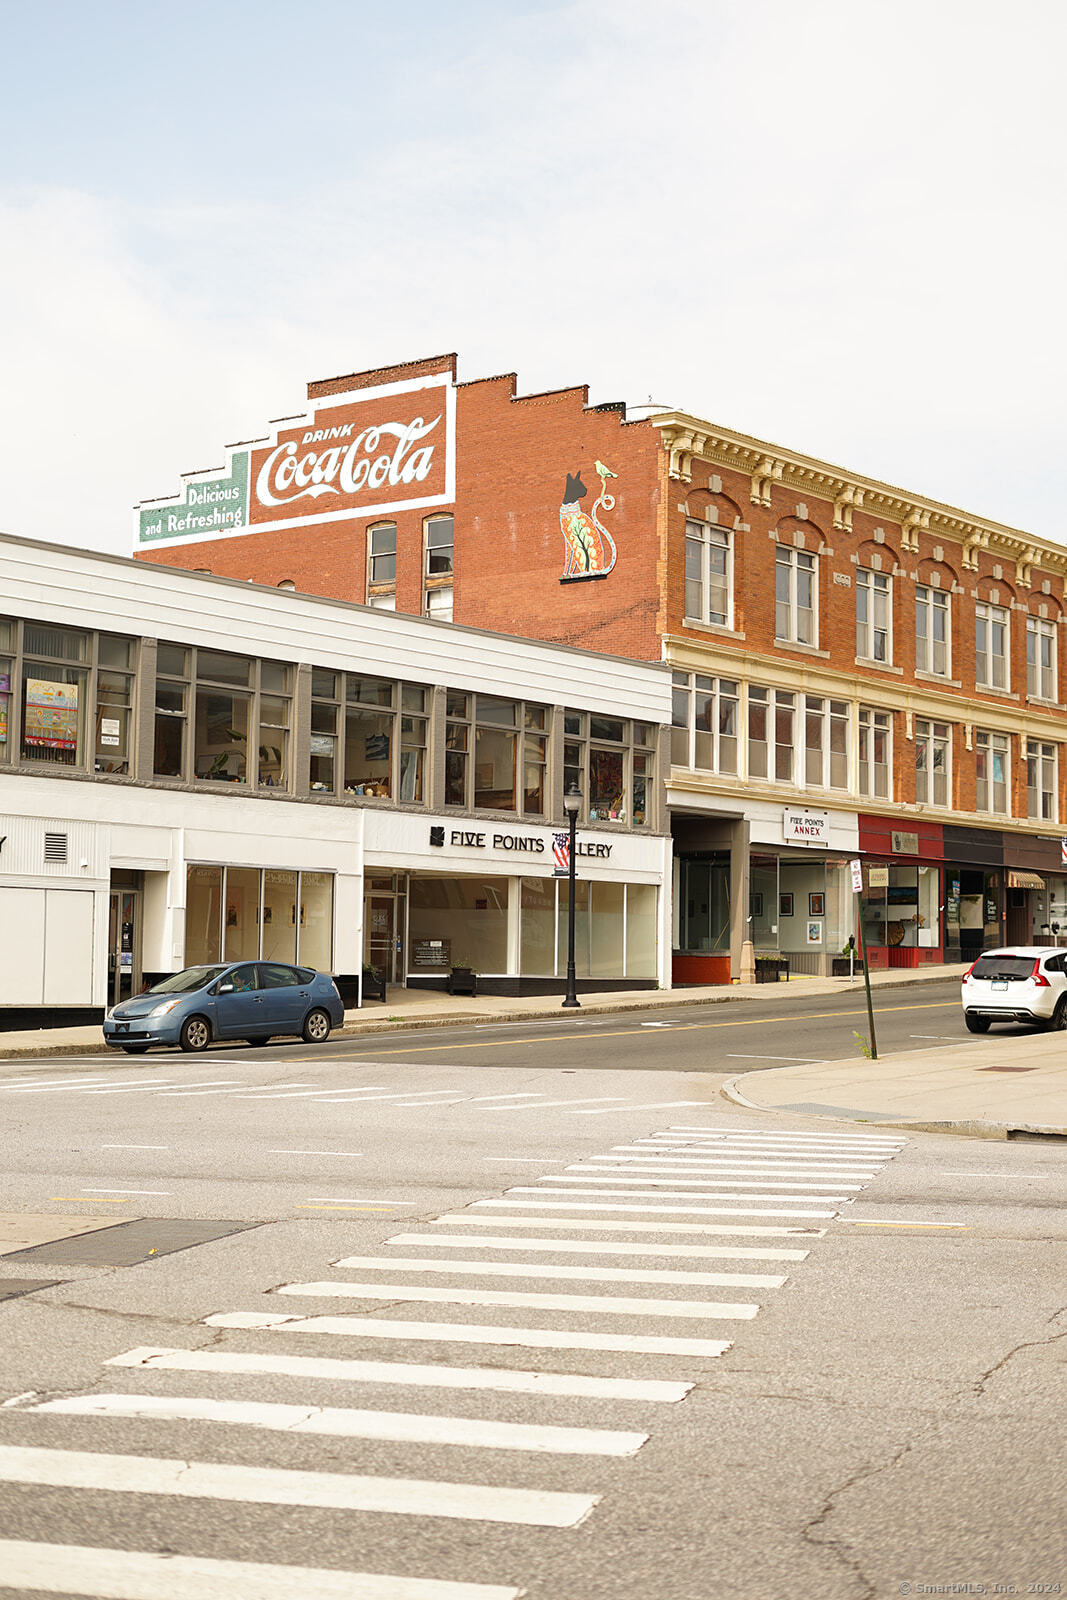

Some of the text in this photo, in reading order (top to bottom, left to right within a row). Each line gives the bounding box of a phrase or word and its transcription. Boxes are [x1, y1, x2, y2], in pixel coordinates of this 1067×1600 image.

[302, 423, 355, 445] DRINK
[256, 414, 443, 507] Coca-Cola
[188, 485, 240, 507] Delicious
[145, 506, 243, 536] and Refreshing
[794, 826, 820, 836] ANNEX
[804, 818, 824, 827] POINTS
[451, 831, 486, 847] FIVE
[493, 834, 544, 853] POINTS
